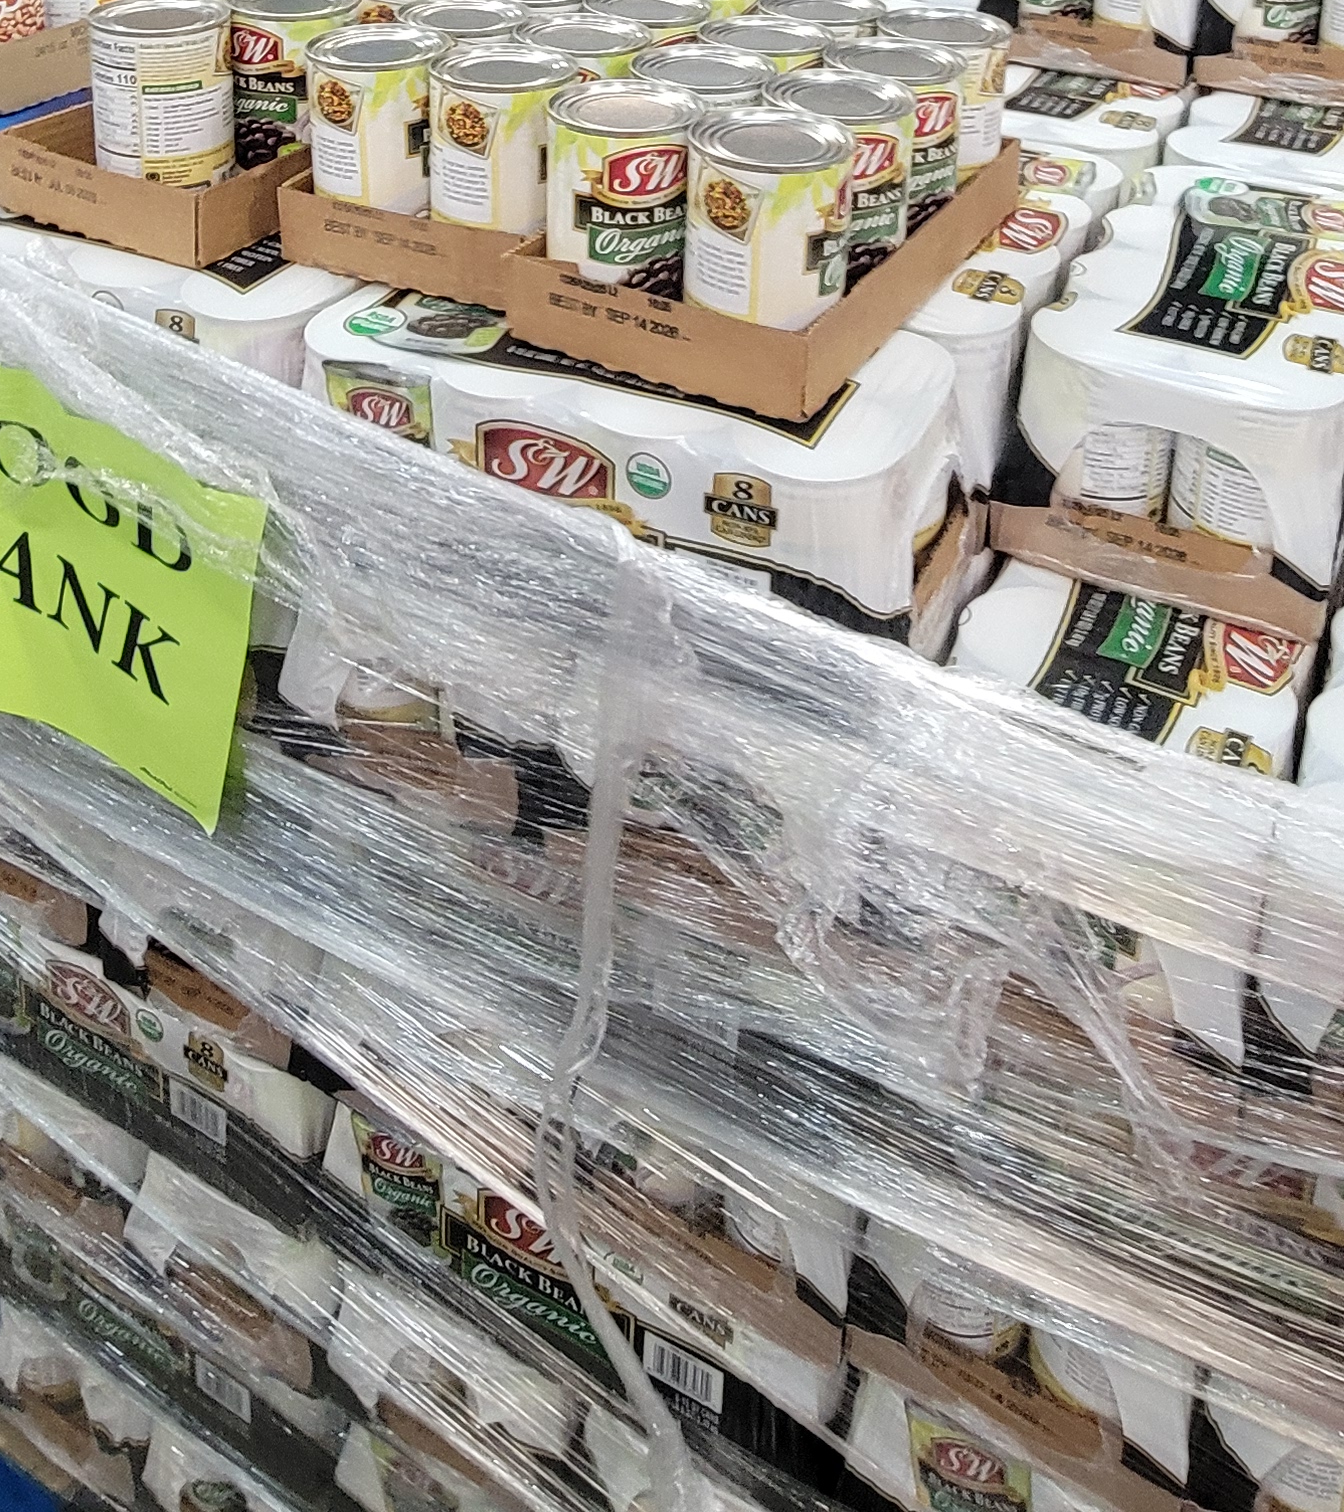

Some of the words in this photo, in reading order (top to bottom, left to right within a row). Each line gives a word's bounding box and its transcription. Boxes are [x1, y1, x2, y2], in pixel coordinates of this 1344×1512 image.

[116, 73, 137, 85] 110
[248, 76, 295, 93] BEANS
[236, 96, 289, 115] ganic
[613, 151, 686, 192] S&W
[591, 206, 651, 226] BLACK
[653, 205, 685, 224] BEA
[1000, 209, 1061, 248] S&W
[1214, 235, 1264, 300] Organic
[1268, 240, 1299, 275] BLACK
[972, 270, 1007, 302] CANS
[998, 284, 1018, 300] 8
[1256, 271, 1284, 308] BEANS
[169, 314, 184, 334] 8
[605, 306, 632, 325] SEP
[632, 314, 648, 332] 14
[649, 318, 680, 340] 2026
[1309, 335, 1339, 374] CANS
[359, 395, 407, 428] S&W
[491, 437, 602, 497] S&W
[733, 479, 754, 502] 8
[710, 499, 772, 526] CANS
[1158, 621, 1201, 676] BEANS
[1222, 736, 1247, 763] CA
[39, 1001, 92, 1044] BLACK
[92, 1034, 145, 1079] BEANS
[200, 1041, 214, 1058] 8
[44, 1028, 139, 1092] Organic
[187, 1049, 226, 1078] CANS
[374, 1135, 420, 1169] S&W
[368, 1162, 404, 1185] BLACK
[403, 1174, 436, 1195] BEANS
[373, 1178, 436, 1208] Organic
[466, 1234, 532, 1287] BLACK
[471, 1261, 599, 1346] Organic
[674, 1298, 729, 1341] CANS
[948, 1437, 1002, 1483] S&W
